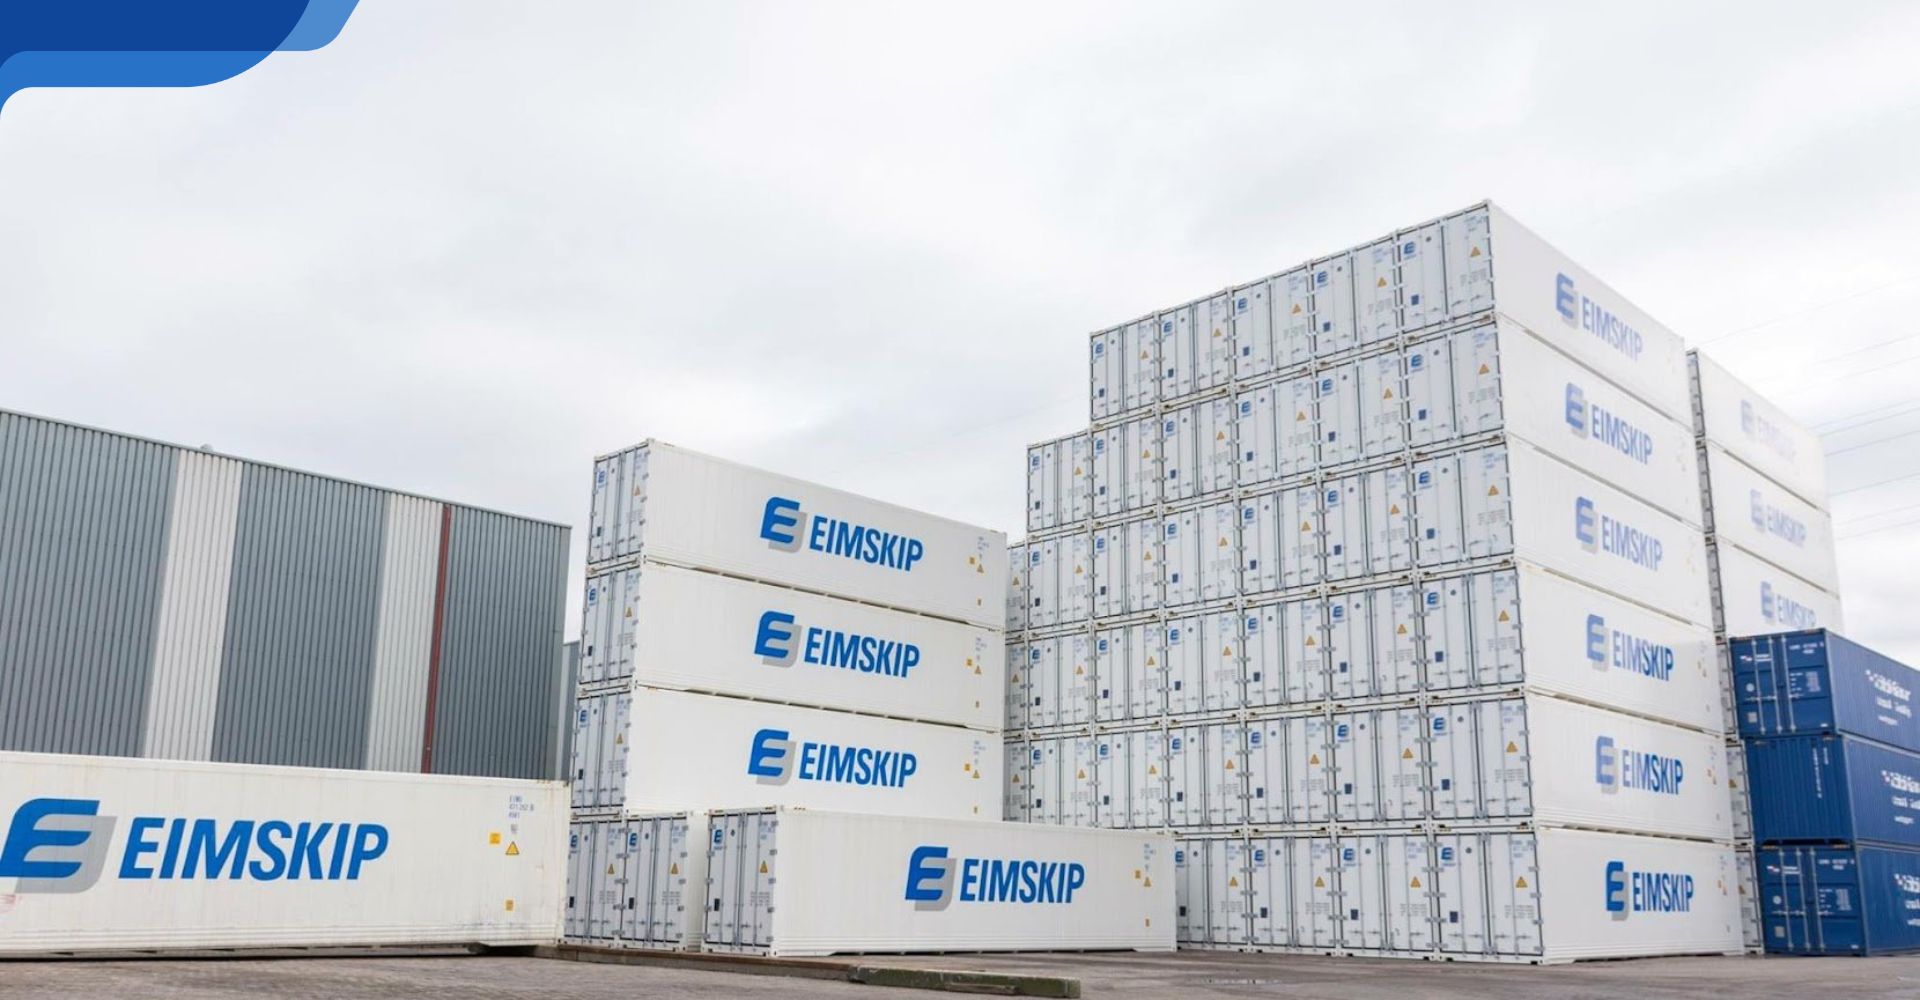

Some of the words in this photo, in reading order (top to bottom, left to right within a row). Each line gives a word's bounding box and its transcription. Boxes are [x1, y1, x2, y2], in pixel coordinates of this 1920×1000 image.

[1582, 297, 1643, 359] EIMSKIP
[1592, 405, 1652, 464] EIMSKIP
[808, 515, 924, 573] EIMSKIP
[1602, 515, 1664, 571] EIMSKIP
[803, 626, 921, 679] EIMSKIP
[1612, 630, 1675, 682] EIMSKIP
[798, 742, 918, 789] EIMSKIP
[1622, 749, 1684, 796] EIMSKIP
[117, 817, 390, 882] EIMSKIP
[959, 857, 1085, 904] EIMSKIP
[1632, 872, 1695, 914] EIMSKIP
